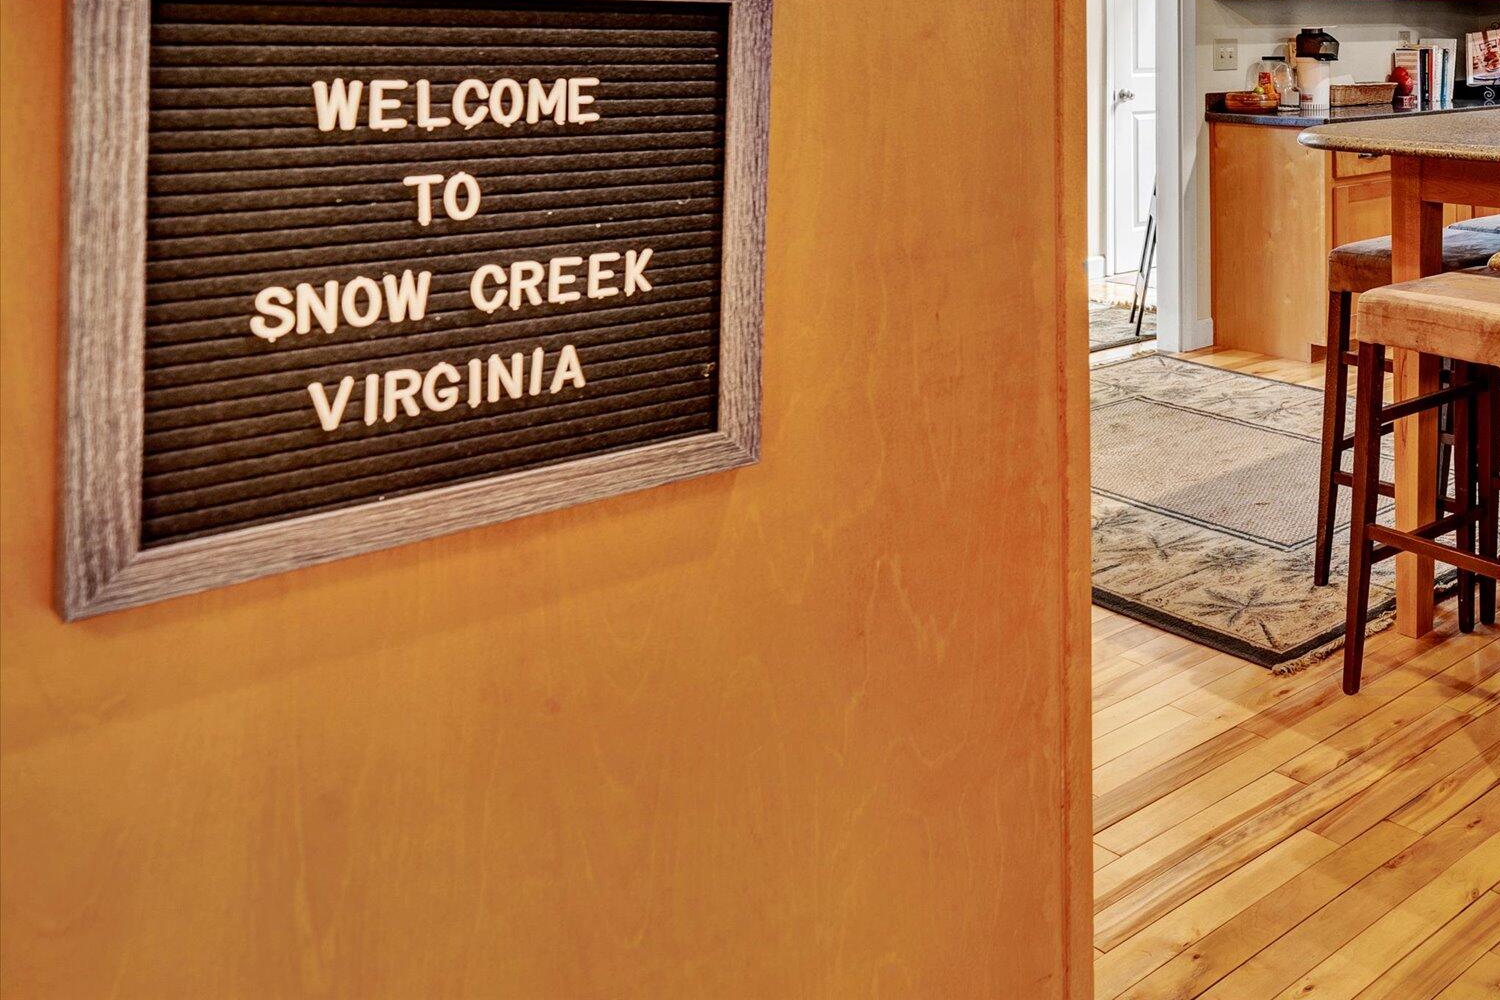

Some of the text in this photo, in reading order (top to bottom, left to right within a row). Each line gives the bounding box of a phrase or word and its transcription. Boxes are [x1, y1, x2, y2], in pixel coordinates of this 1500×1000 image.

[311, 77, 600, 132] WELCOME
[402, 171, 481, 227] TO
[249, 248, 654, 343] SNOW CREEK
[307, 344, 586, 431] VIRGINIA
